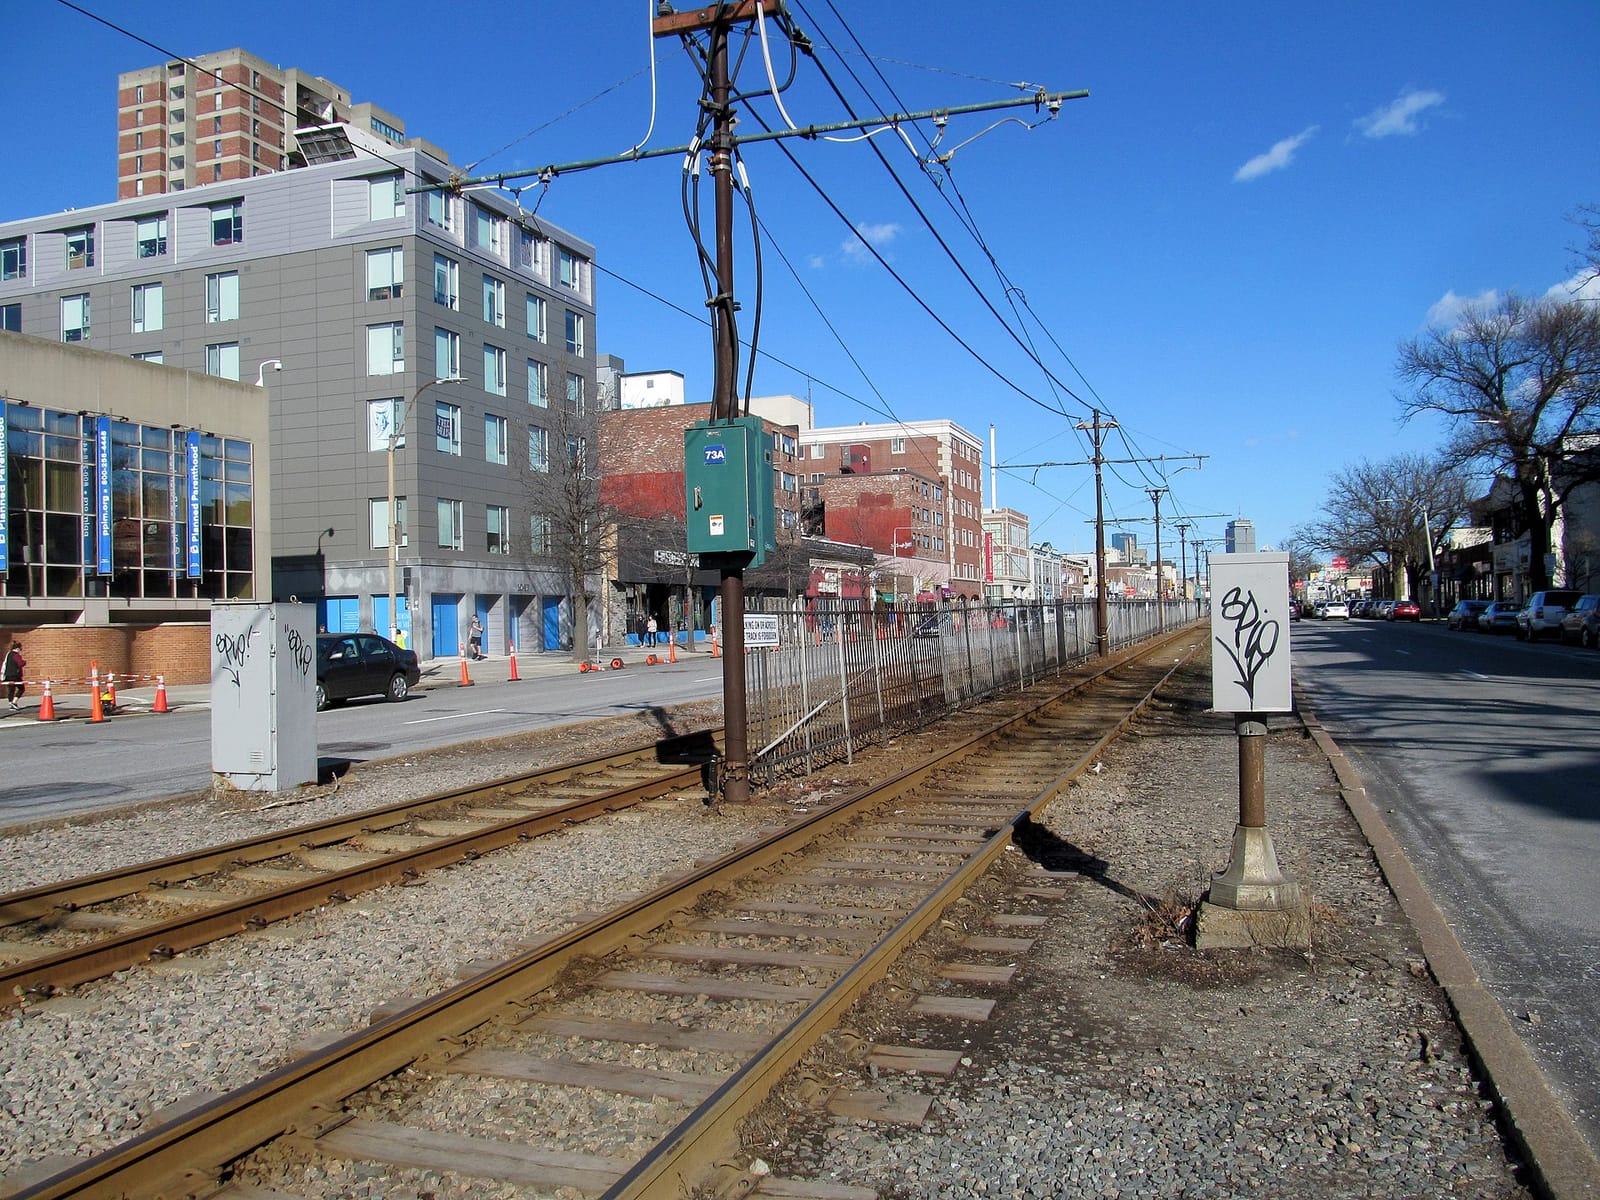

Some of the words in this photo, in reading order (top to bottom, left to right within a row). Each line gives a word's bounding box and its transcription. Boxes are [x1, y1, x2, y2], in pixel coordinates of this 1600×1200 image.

[191, 445, 199, 501] Parenthood
[705, 452, 725, 460] 73A
[102, 495, 110, 536] pplm.org
[191, 504, 199, 542] Planned
